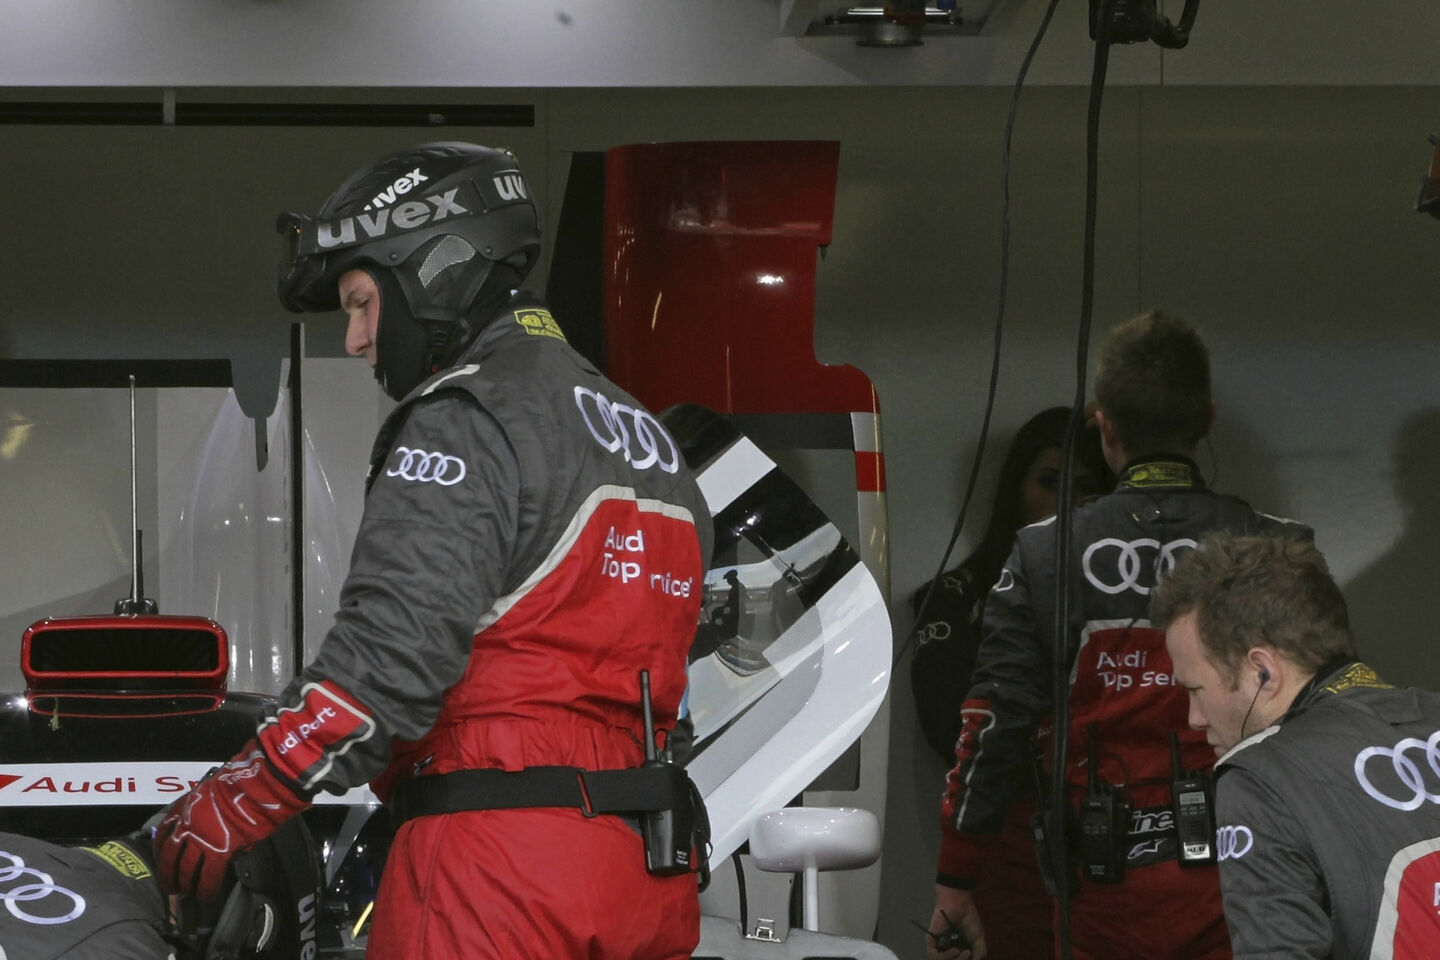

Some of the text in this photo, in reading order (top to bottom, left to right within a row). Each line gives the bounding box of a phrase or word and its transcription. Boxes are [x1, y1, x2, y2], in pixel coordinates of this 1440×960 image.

[317, 187, 467, 248] uvex
[601, 552, 642, 584] Top
[21, 776, 137, 793] Audi
